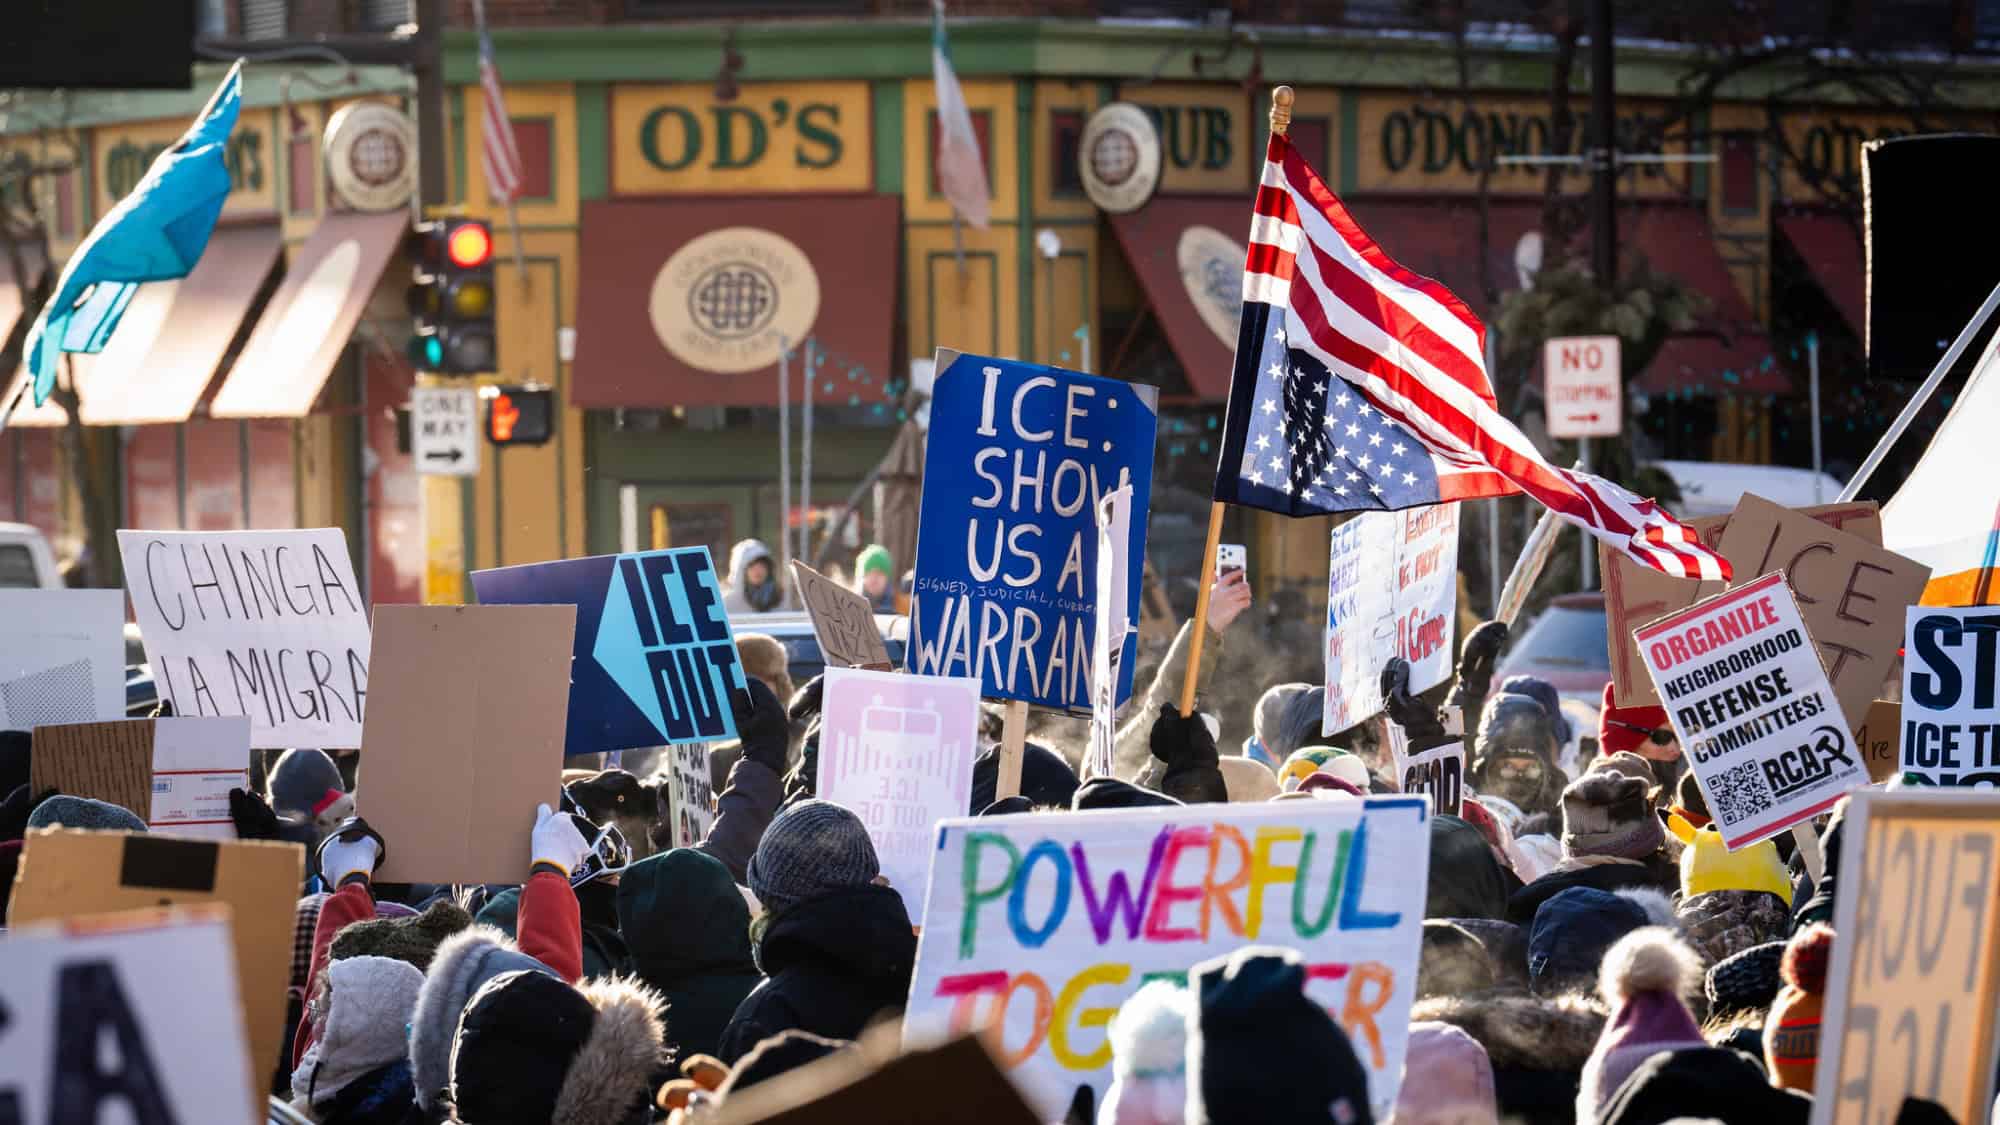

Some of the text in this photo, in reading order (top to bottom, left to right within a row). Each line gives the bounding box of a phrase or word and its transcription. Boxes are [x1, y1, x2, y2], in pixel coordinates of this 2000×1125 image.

[638, 98, 844, 172] OD'S
[1143, 106, 1232, 170] UB
[1561, 345, 1604, 371] NO
[422, 394, 466, 414] ONE
[976, 366, 1118, 453] ICE:
[146, 540, 357, 631] CHINGA
[968, 518, 1084, 599] US A
[1757, 519, 1894, 627] ICE
[619, 552, 730, 648] ICE
[1057, 599, 1097, 616] CURRE
[1329, 592, 1358, 629] KKK
[1650, 595, 1780, 671] ORGANIZE
[226, 647, 368, 727] MIGRA
[912, 594, 1097, 705] WARRAN
[1664, 628, 1802, 701] NEIGHBORHOOD
[646, 644, 736, 740] OUT
[1677, 667, 1792, 737] DEFENSE
[1694, 691, 1825, 763] COMMITTEES!
[1762, 744, 1823, 793] RCA
[1905, 720, 1962, 768] ICE
[960, 817, 1401, 960] POWERFUL
[936, 961, 1395, 1070] TOGR
